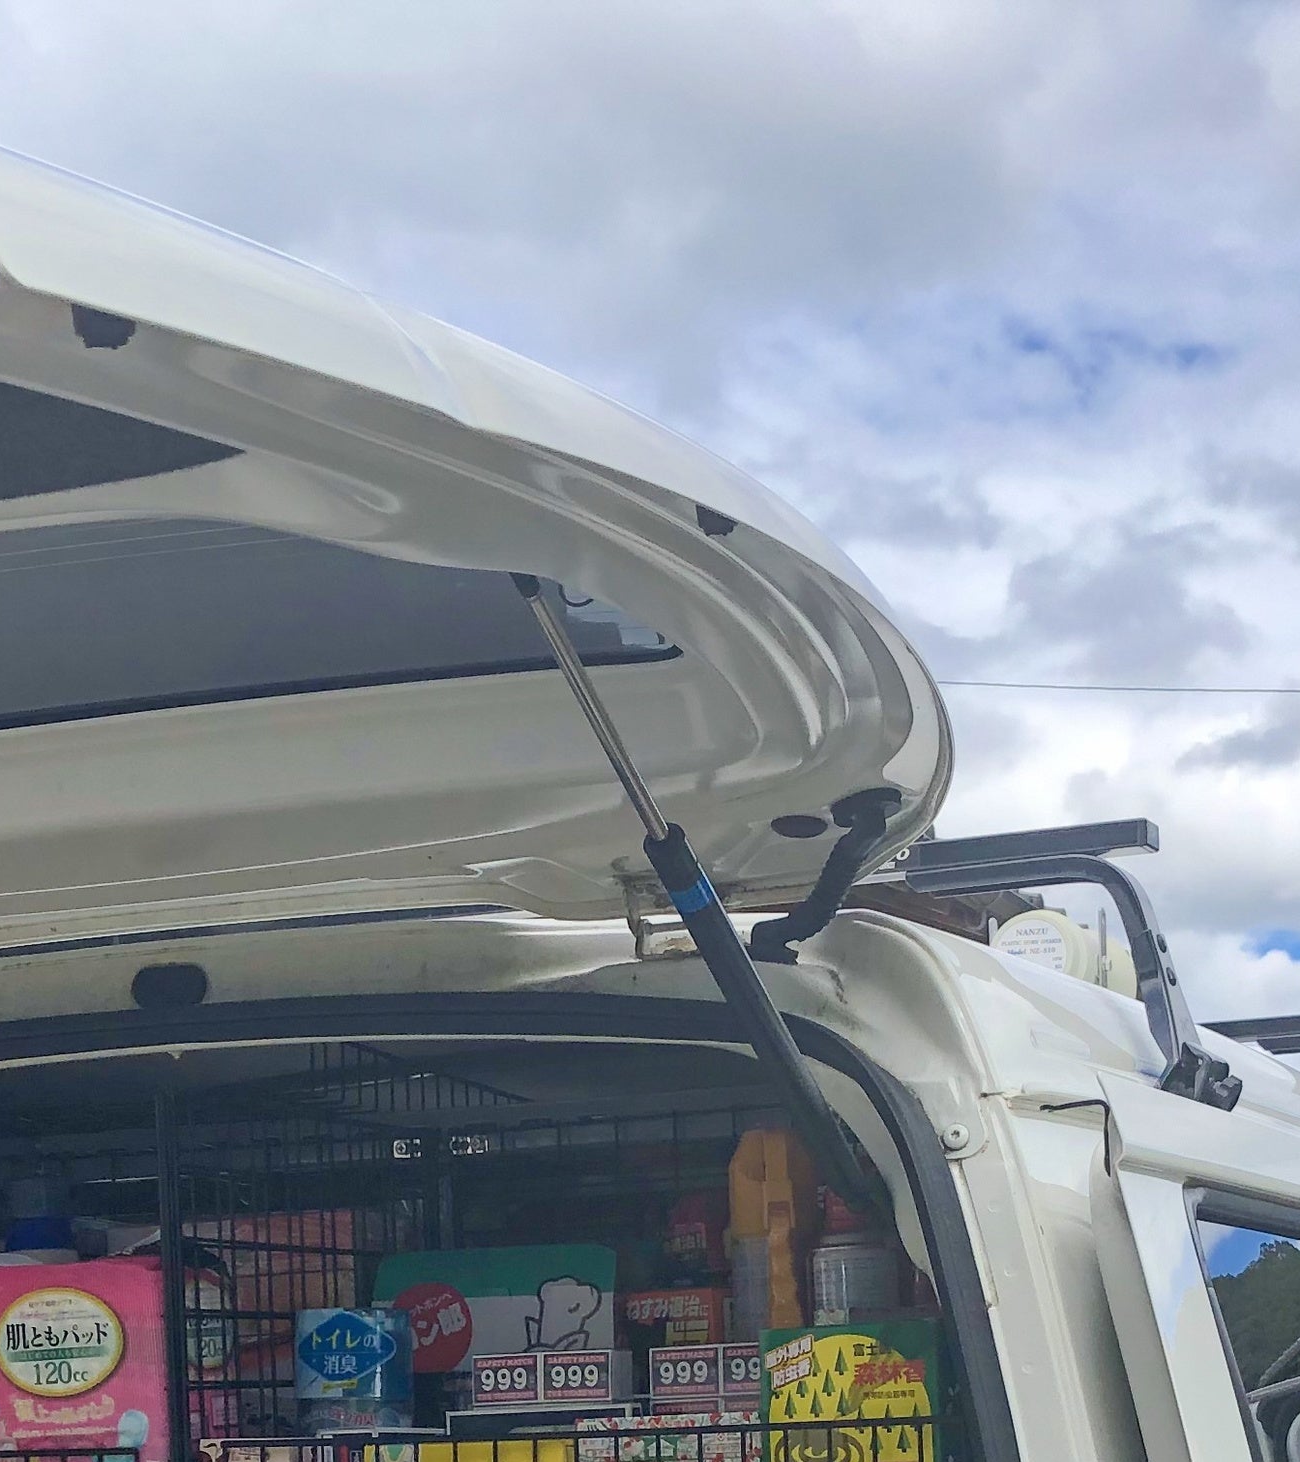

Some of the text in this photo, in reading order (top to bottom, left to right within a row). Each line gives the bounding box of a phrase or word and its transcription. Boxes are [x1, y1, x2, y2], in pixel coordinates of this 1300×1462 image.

[1015, 927, 1049, 937] NANZU
[5, 1322, 110, 1351] 肌ともパッド
[311, 1329, 379, 1351] トイレの
[33, 1360, 89, 1386] 120cc
[323, 1354, 359, 1375] 消臭
[550, 1363, 600, 1389] 999
[659, 1360, 709, 1385] 999
[480, 1367, 528, 1392] 999
